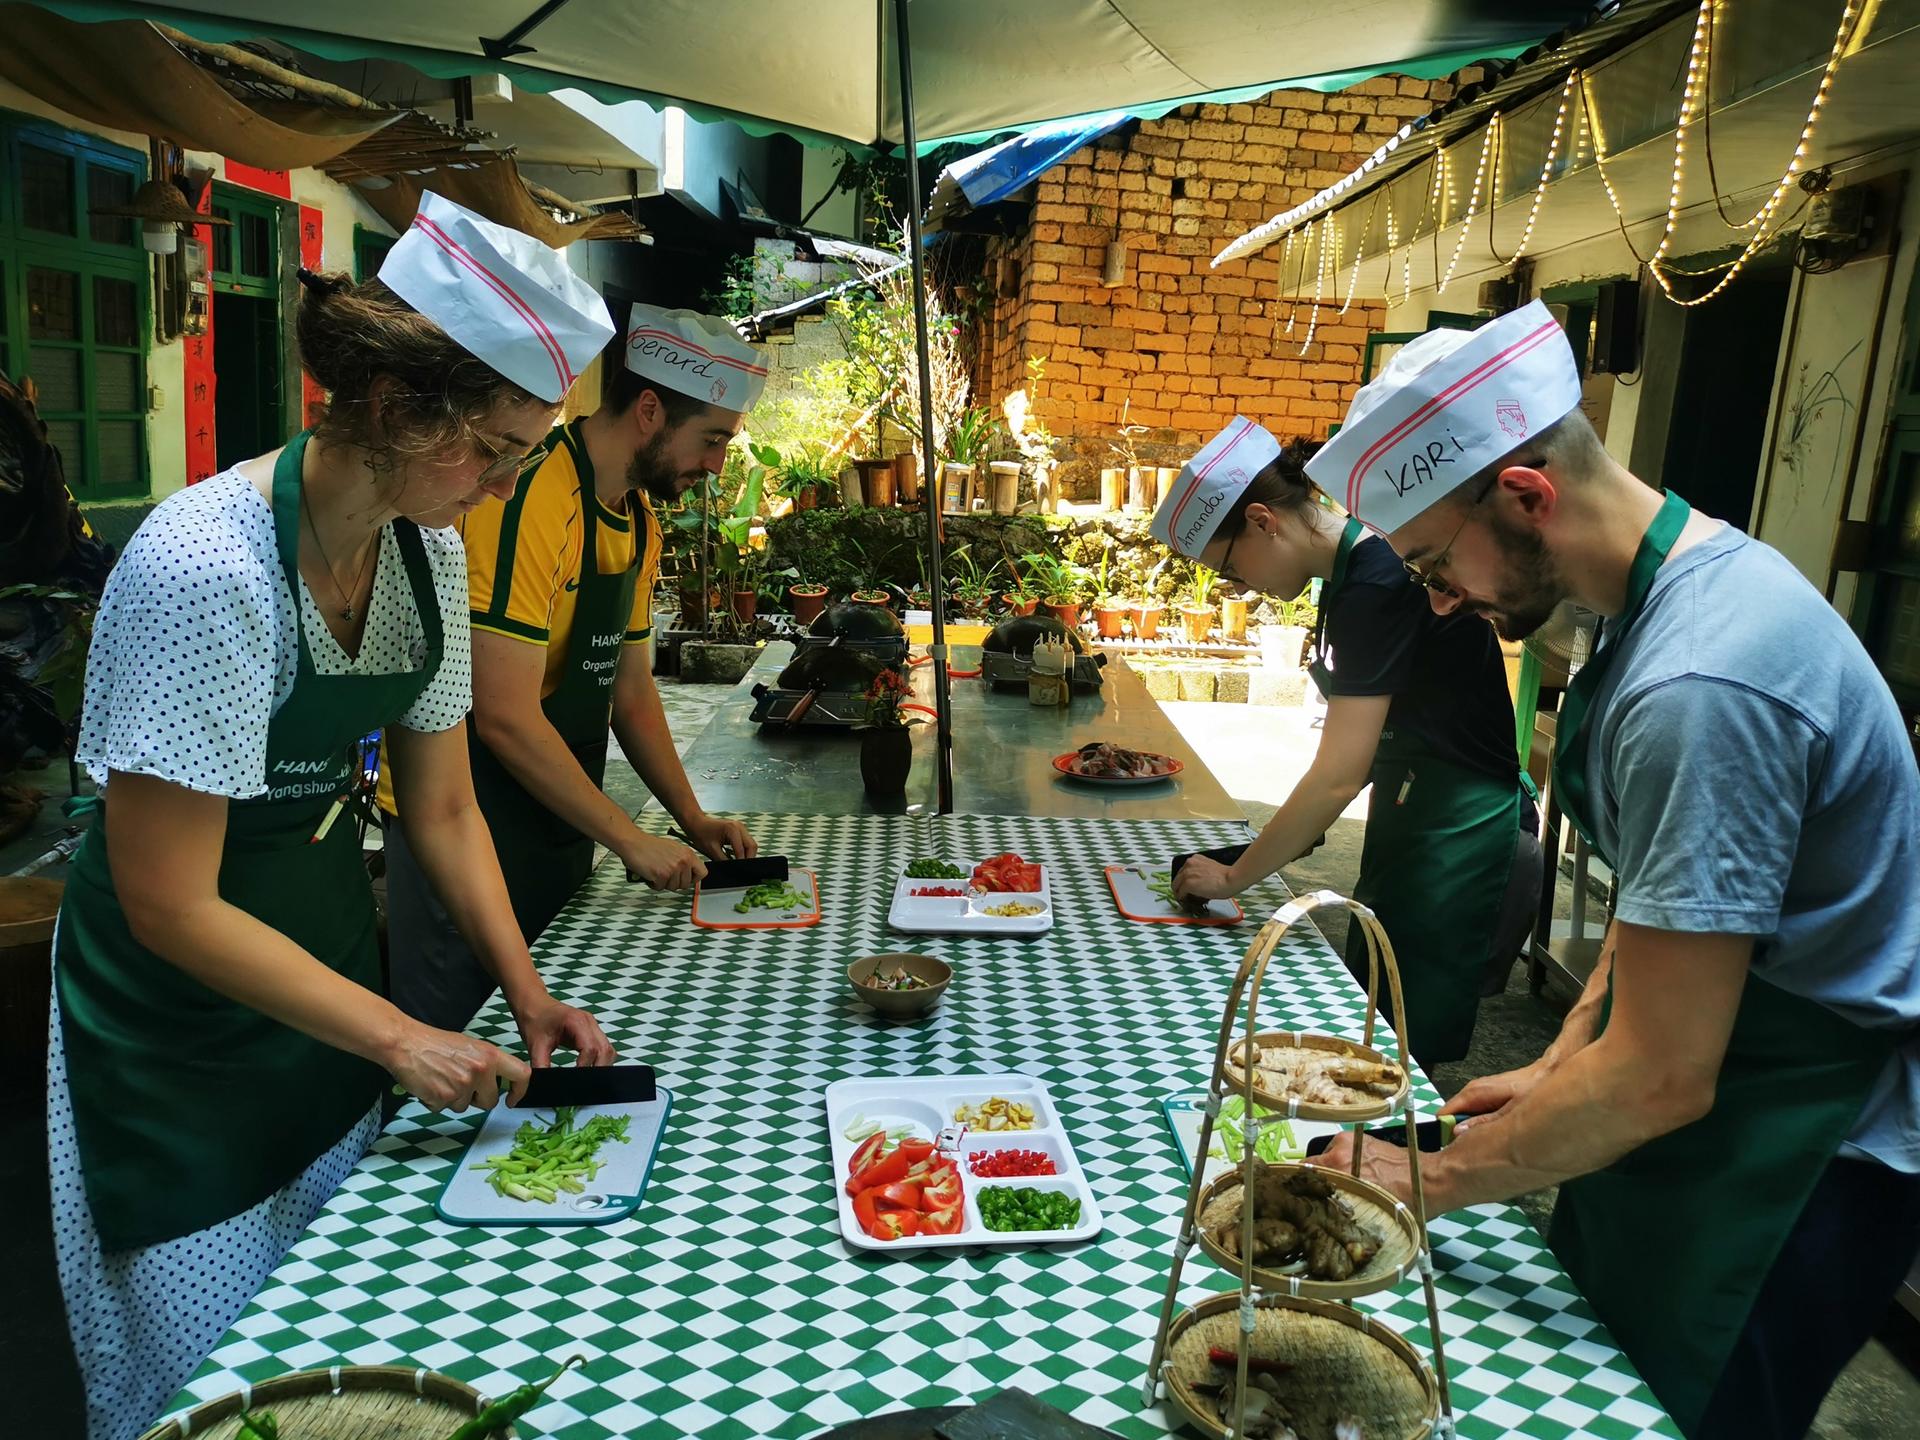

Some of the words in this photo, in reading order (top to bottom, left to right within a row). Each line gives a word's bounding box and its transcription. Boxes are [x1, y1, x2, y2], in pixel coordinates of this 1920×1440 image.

[631, 324, 714, 378] Gerard
[1176, 491, 1225, 550] Amanda
[266, 781, 336, 801] Yangshuo
